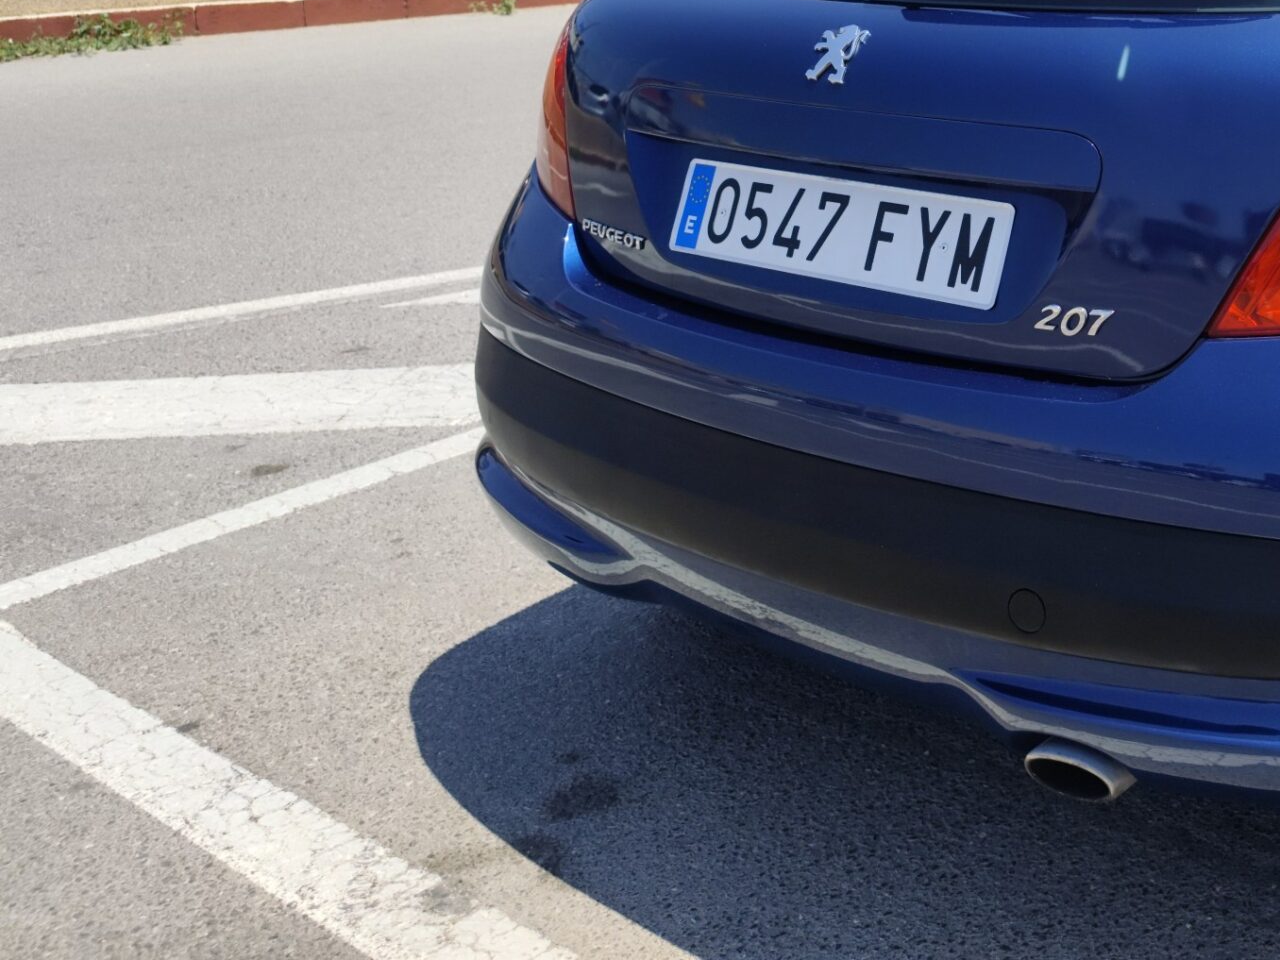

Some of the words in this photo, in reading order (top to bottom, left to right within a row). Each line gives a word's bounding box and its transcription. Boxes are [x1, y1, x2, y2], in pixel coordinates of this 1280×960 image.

[582, 218, 645, 251] PEUGEOT
[684, 214, 697, 235] E
[706, 176, 851, 263] 0547
[863, 200, 996, 294] FYM
[1034, 304, 1115, 337] 207
